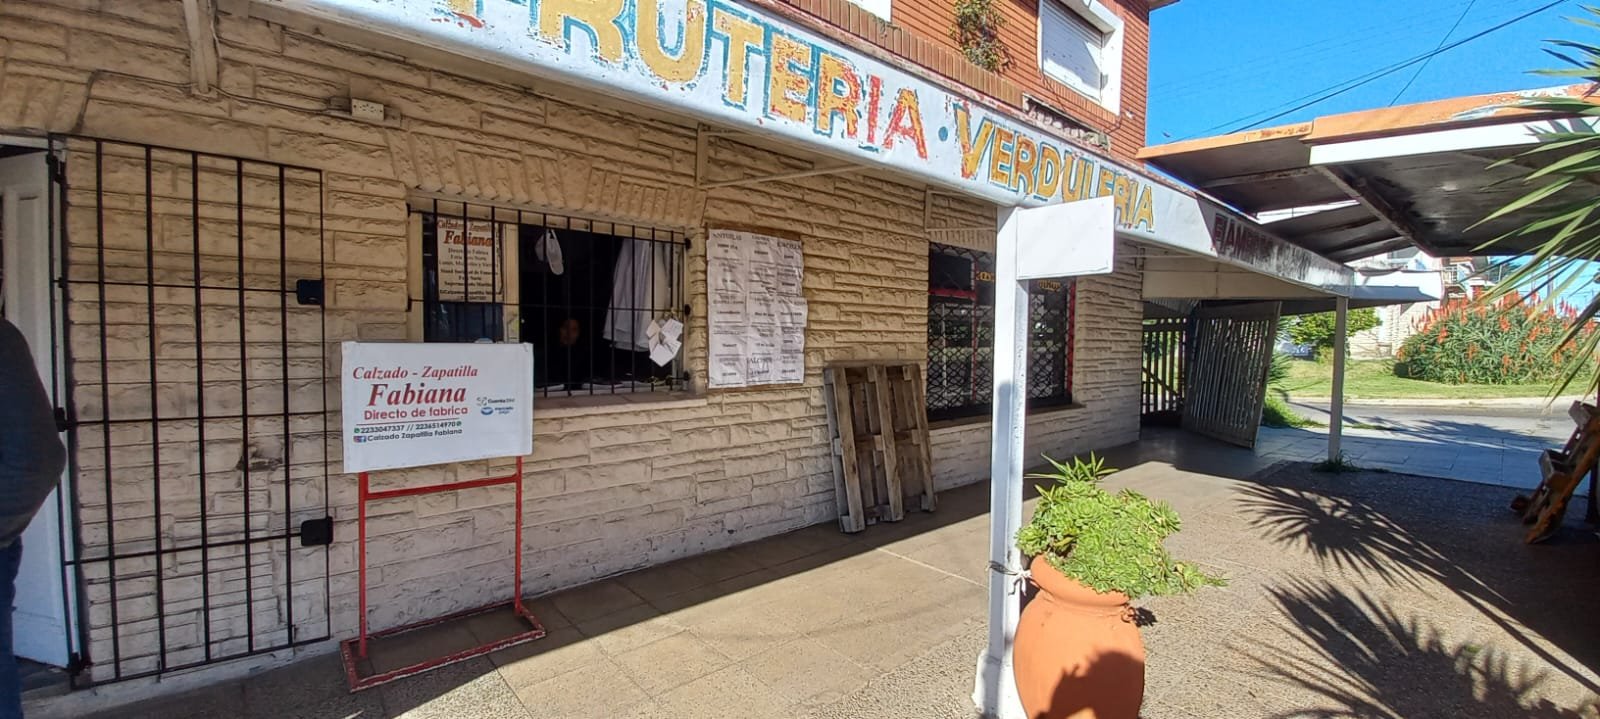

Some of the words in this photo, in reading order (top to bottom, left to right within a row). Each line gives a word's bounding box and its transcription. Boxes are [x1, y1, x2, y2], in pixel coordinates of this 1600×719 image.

[446, 0, 929, 161] RUTERIA
[953, 102, 1155, 233] VERDULERIA
[352, 366, 409, 380] Calzado
[421, 365, 479, 381] Zapatilla
[366, 382, 468, 407] Fabiana
[363, 408, 408, 421] Directo
[411, 407, 426, 418] de
[429, 405, 468, 416] fabrica
[367, 433, 400, 442] Calzado
[401, 429, 433, 440] Zapatilla
[434, 427, 463, 437] Fabiana
